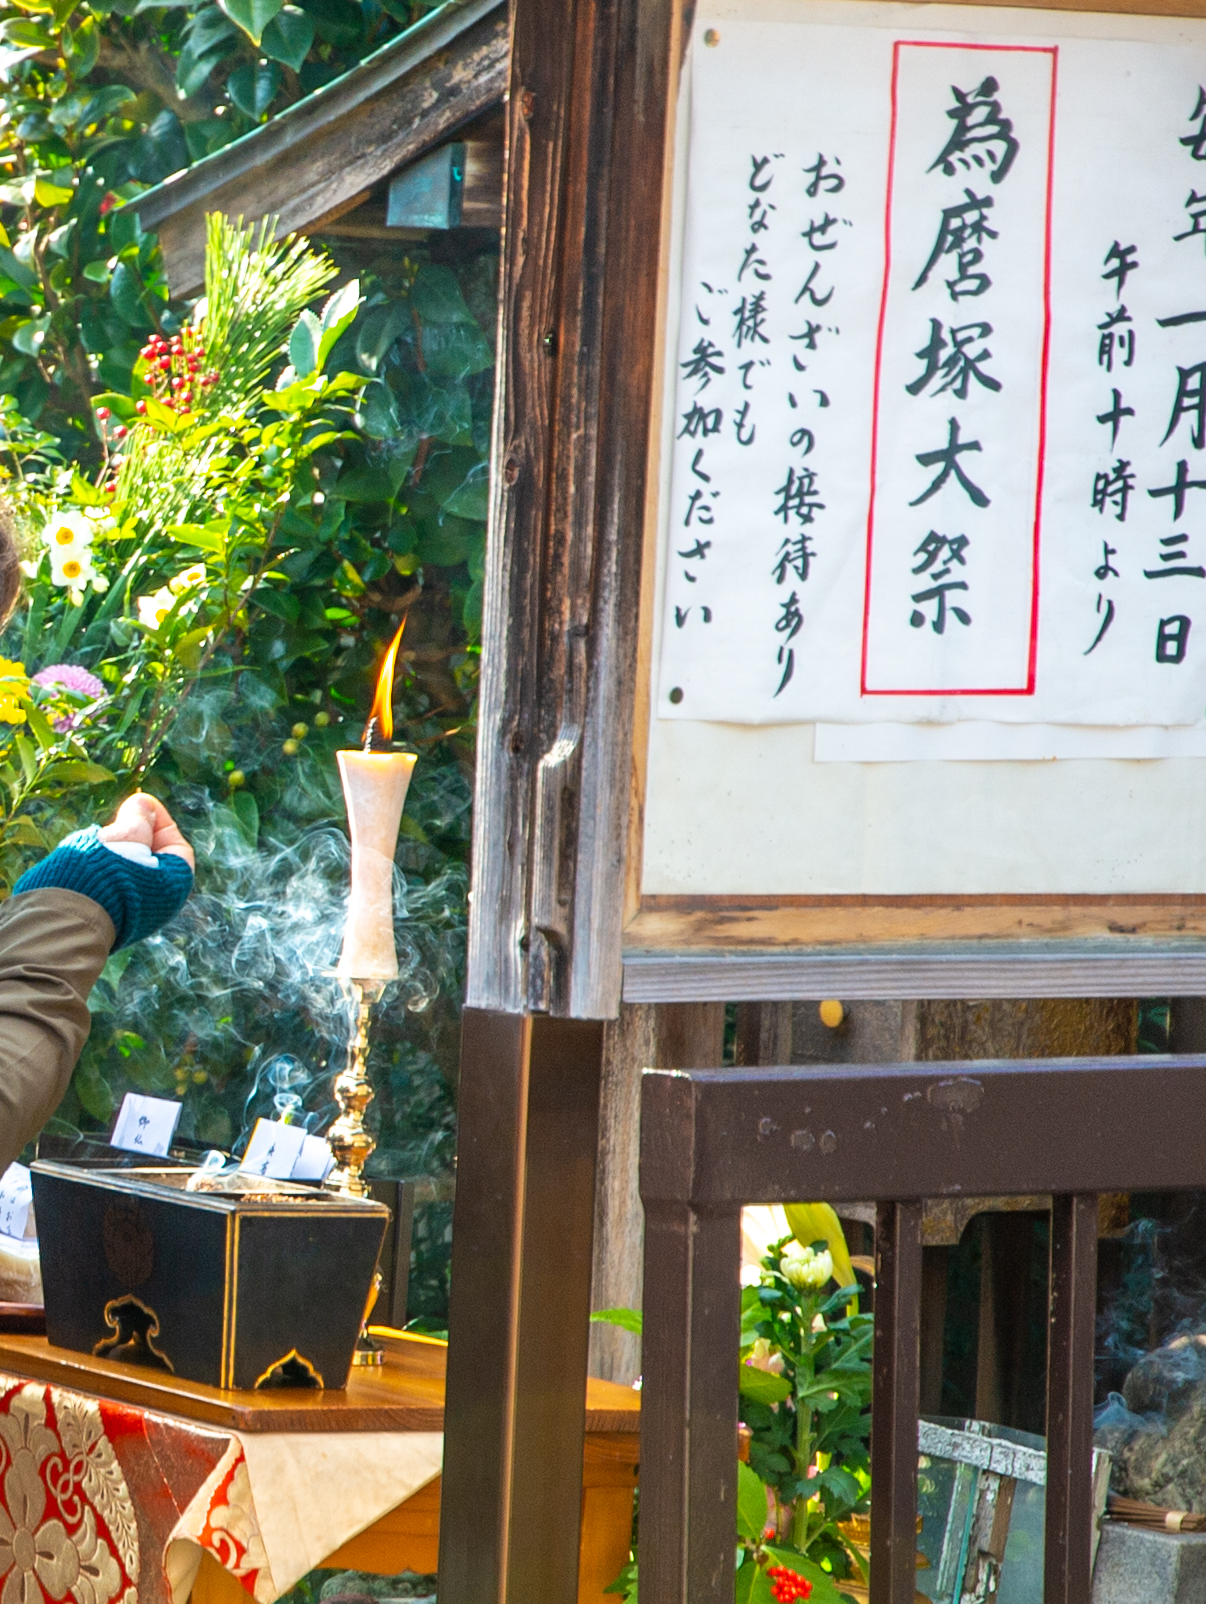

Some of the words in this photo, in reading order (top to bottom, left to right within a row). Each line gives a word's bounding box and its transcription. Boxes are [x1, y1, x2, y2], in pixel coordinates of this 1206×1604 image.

[675, 281, 729, 629] ご参加ください
[732, 153, 786, 446] どなた様でも
[772, 152, 853, 698] おぜんざいの接待あり
[1087, 240, 1140, 655] 午前十時より
